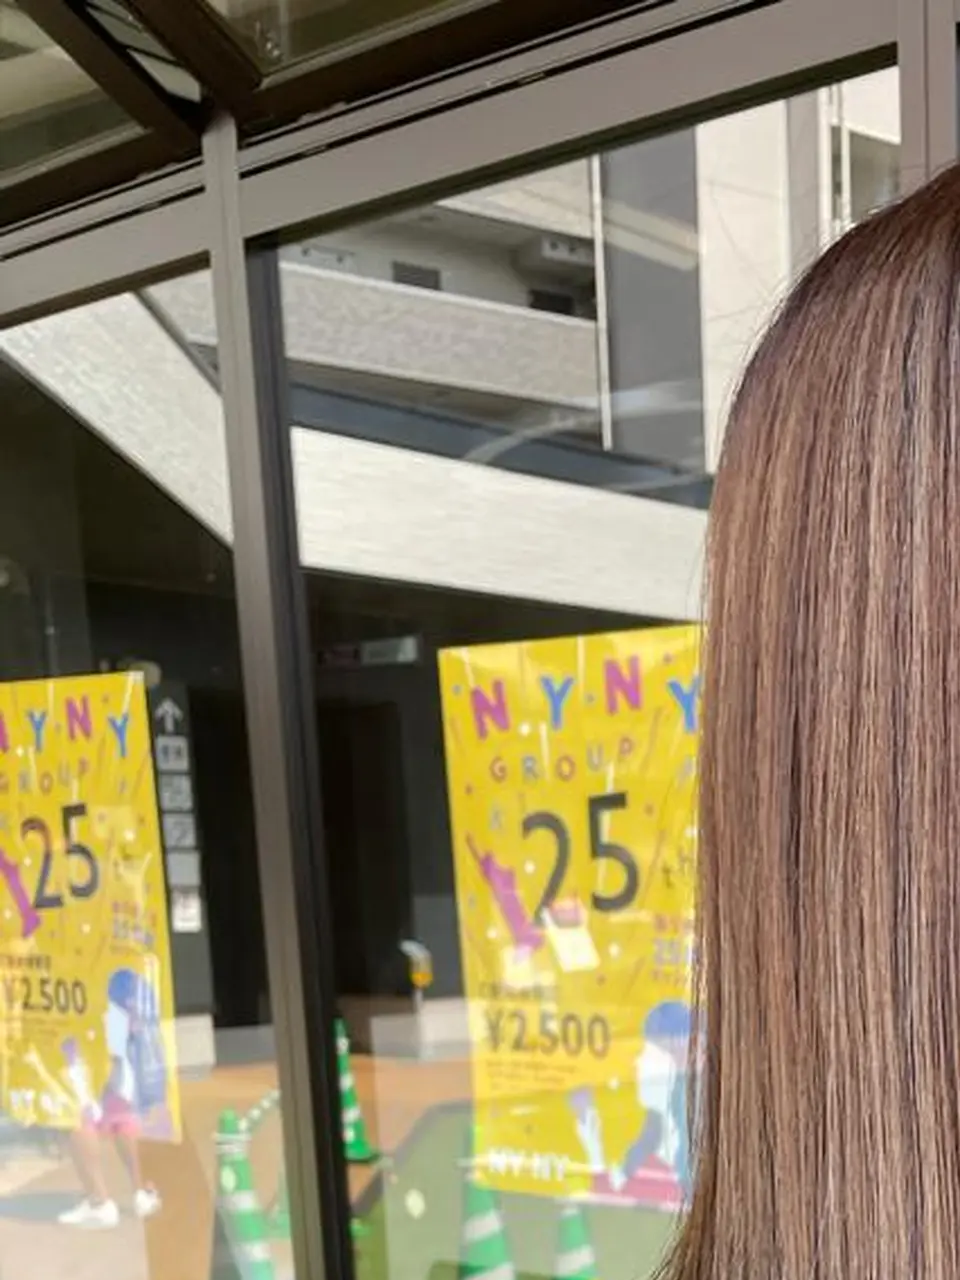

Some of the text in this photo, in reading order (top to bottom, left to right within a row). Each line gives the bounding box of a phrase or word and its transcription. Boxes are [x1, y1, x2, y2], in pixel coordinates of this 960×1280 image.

[489, 737, 635, 783] GROUP
[20, 803, 99, 908] 25
[522, 791, 640, 928] 25
